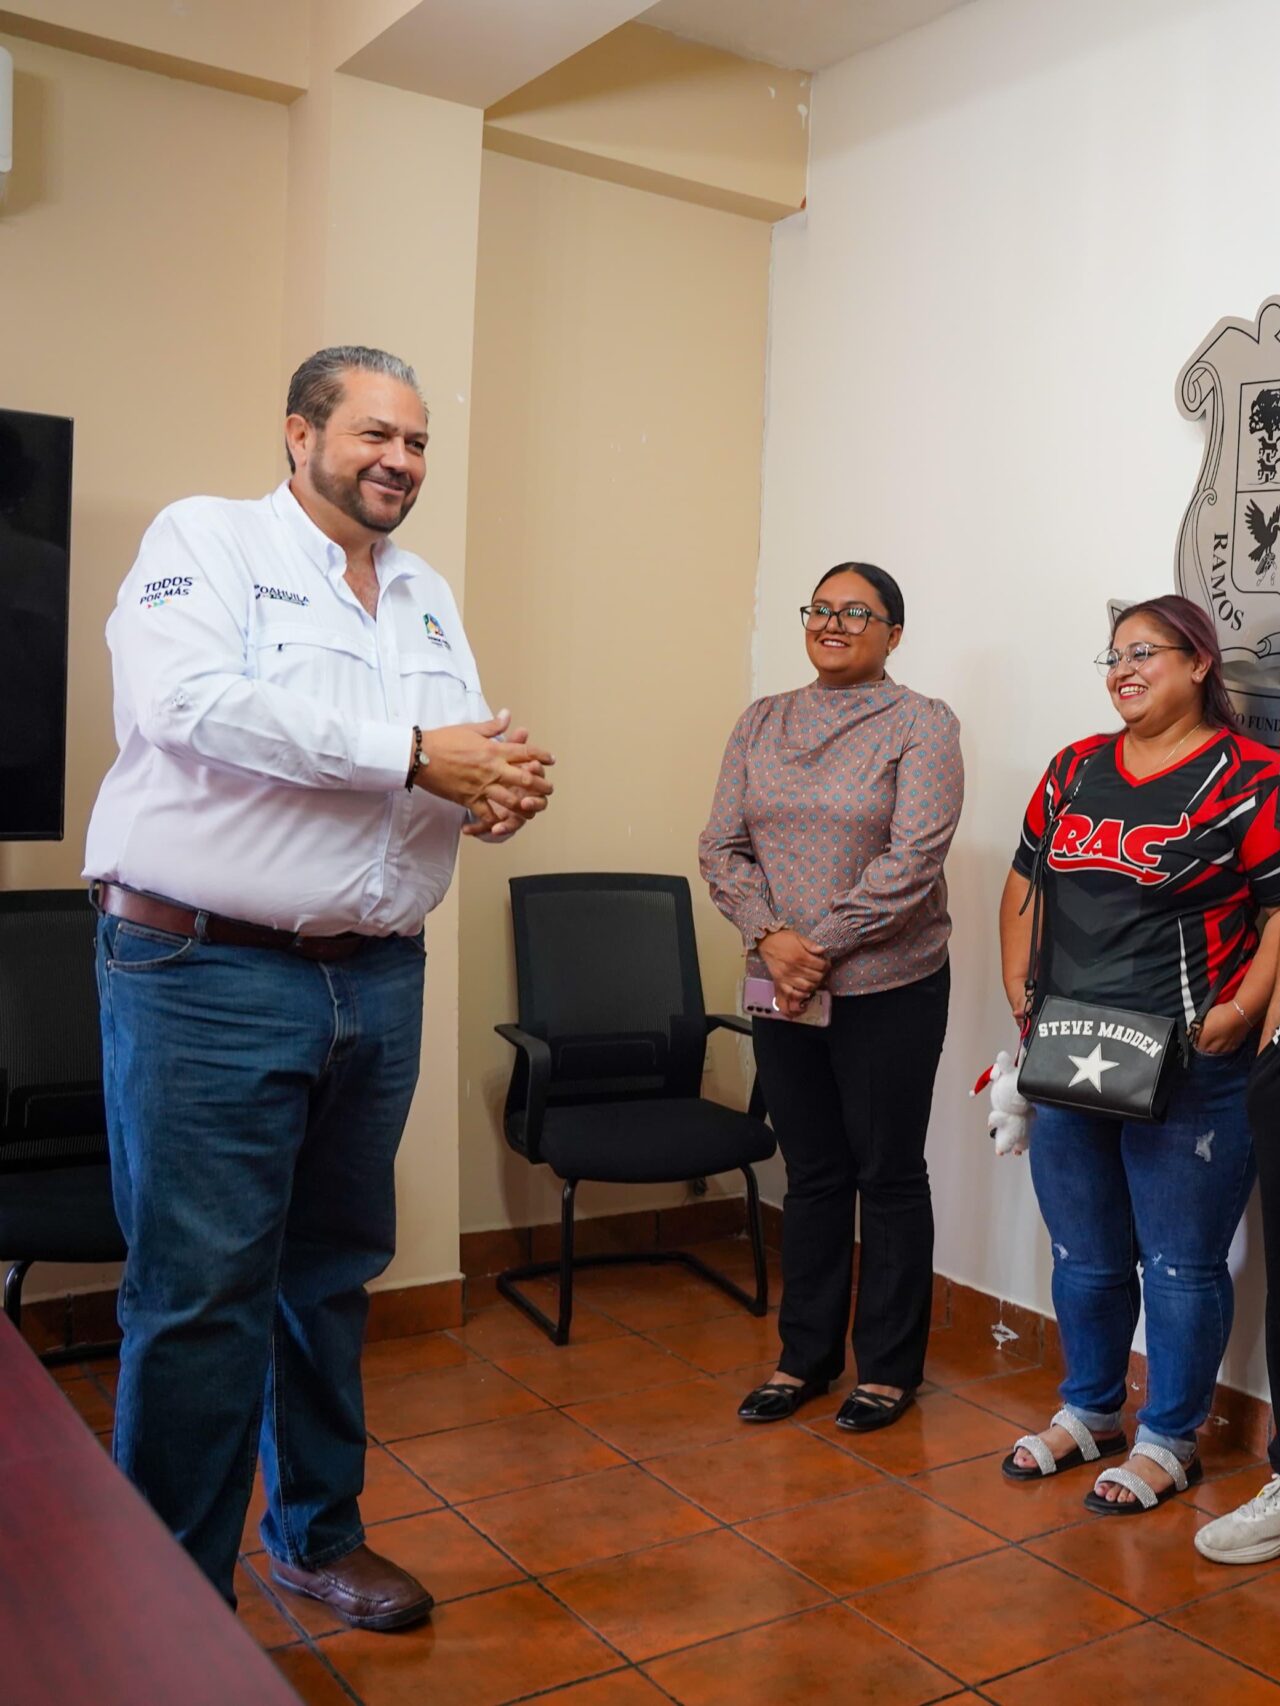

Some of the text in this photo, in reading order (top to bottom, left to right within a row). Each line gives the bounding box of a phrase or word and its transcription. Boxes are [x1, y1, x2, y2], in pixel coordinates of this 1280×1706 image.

[139, 585, 191, 605] POR MÁS
[144, 576, 194, 594] TODOS
[1211, 533, 1245, 631] RAMOS
[1050, 803, 1191, 867] RAC
[1038, 1020, 1163, 1058] STEVE MADDEN
